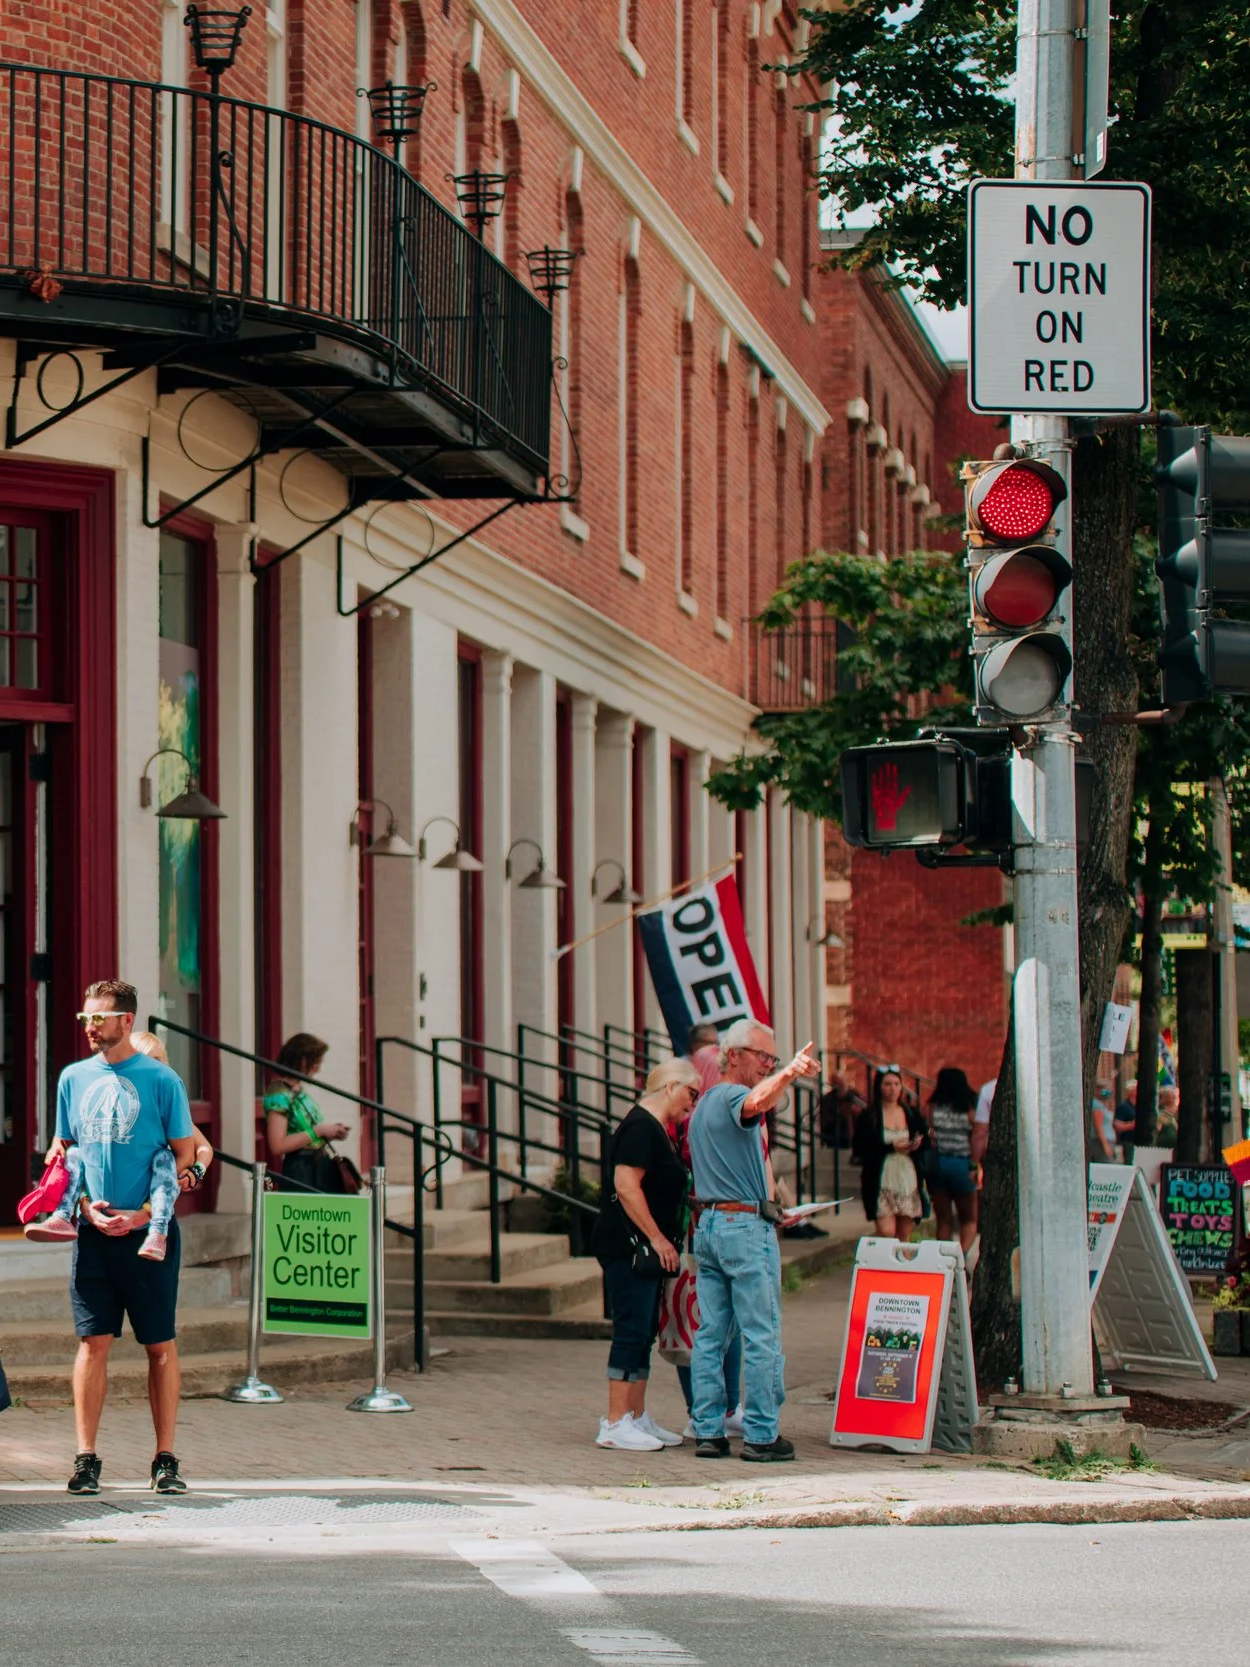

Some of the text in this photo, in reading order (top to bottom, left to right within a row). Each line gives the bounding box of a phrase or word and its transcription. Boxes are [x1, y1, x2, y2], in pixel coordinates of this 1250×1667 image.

[1025, 204, 1093, 246] NO
[1012, 261, 1107, 295] TURN
[1036, 310, 1083, 343] ON
[1024, 359, 1095, 393] RED
[1170, 1180, 1230, 1199] FOOD
[282, 1205, 351, 1222] Downtown
[1167, 1196, 1233, 1216] TREATS
[1169, 1213, 1232, 1231] TOYS
[276, 1224, 358, 1256] Visitor
[273, 1256, 361, 1288] Center
[270, 1304, 363, 1318] Better Bennington Corporation
[875, 1305, 921, 1314] BENNINGTON
[878, 1297, 920, 1307] DOWNTOWN
